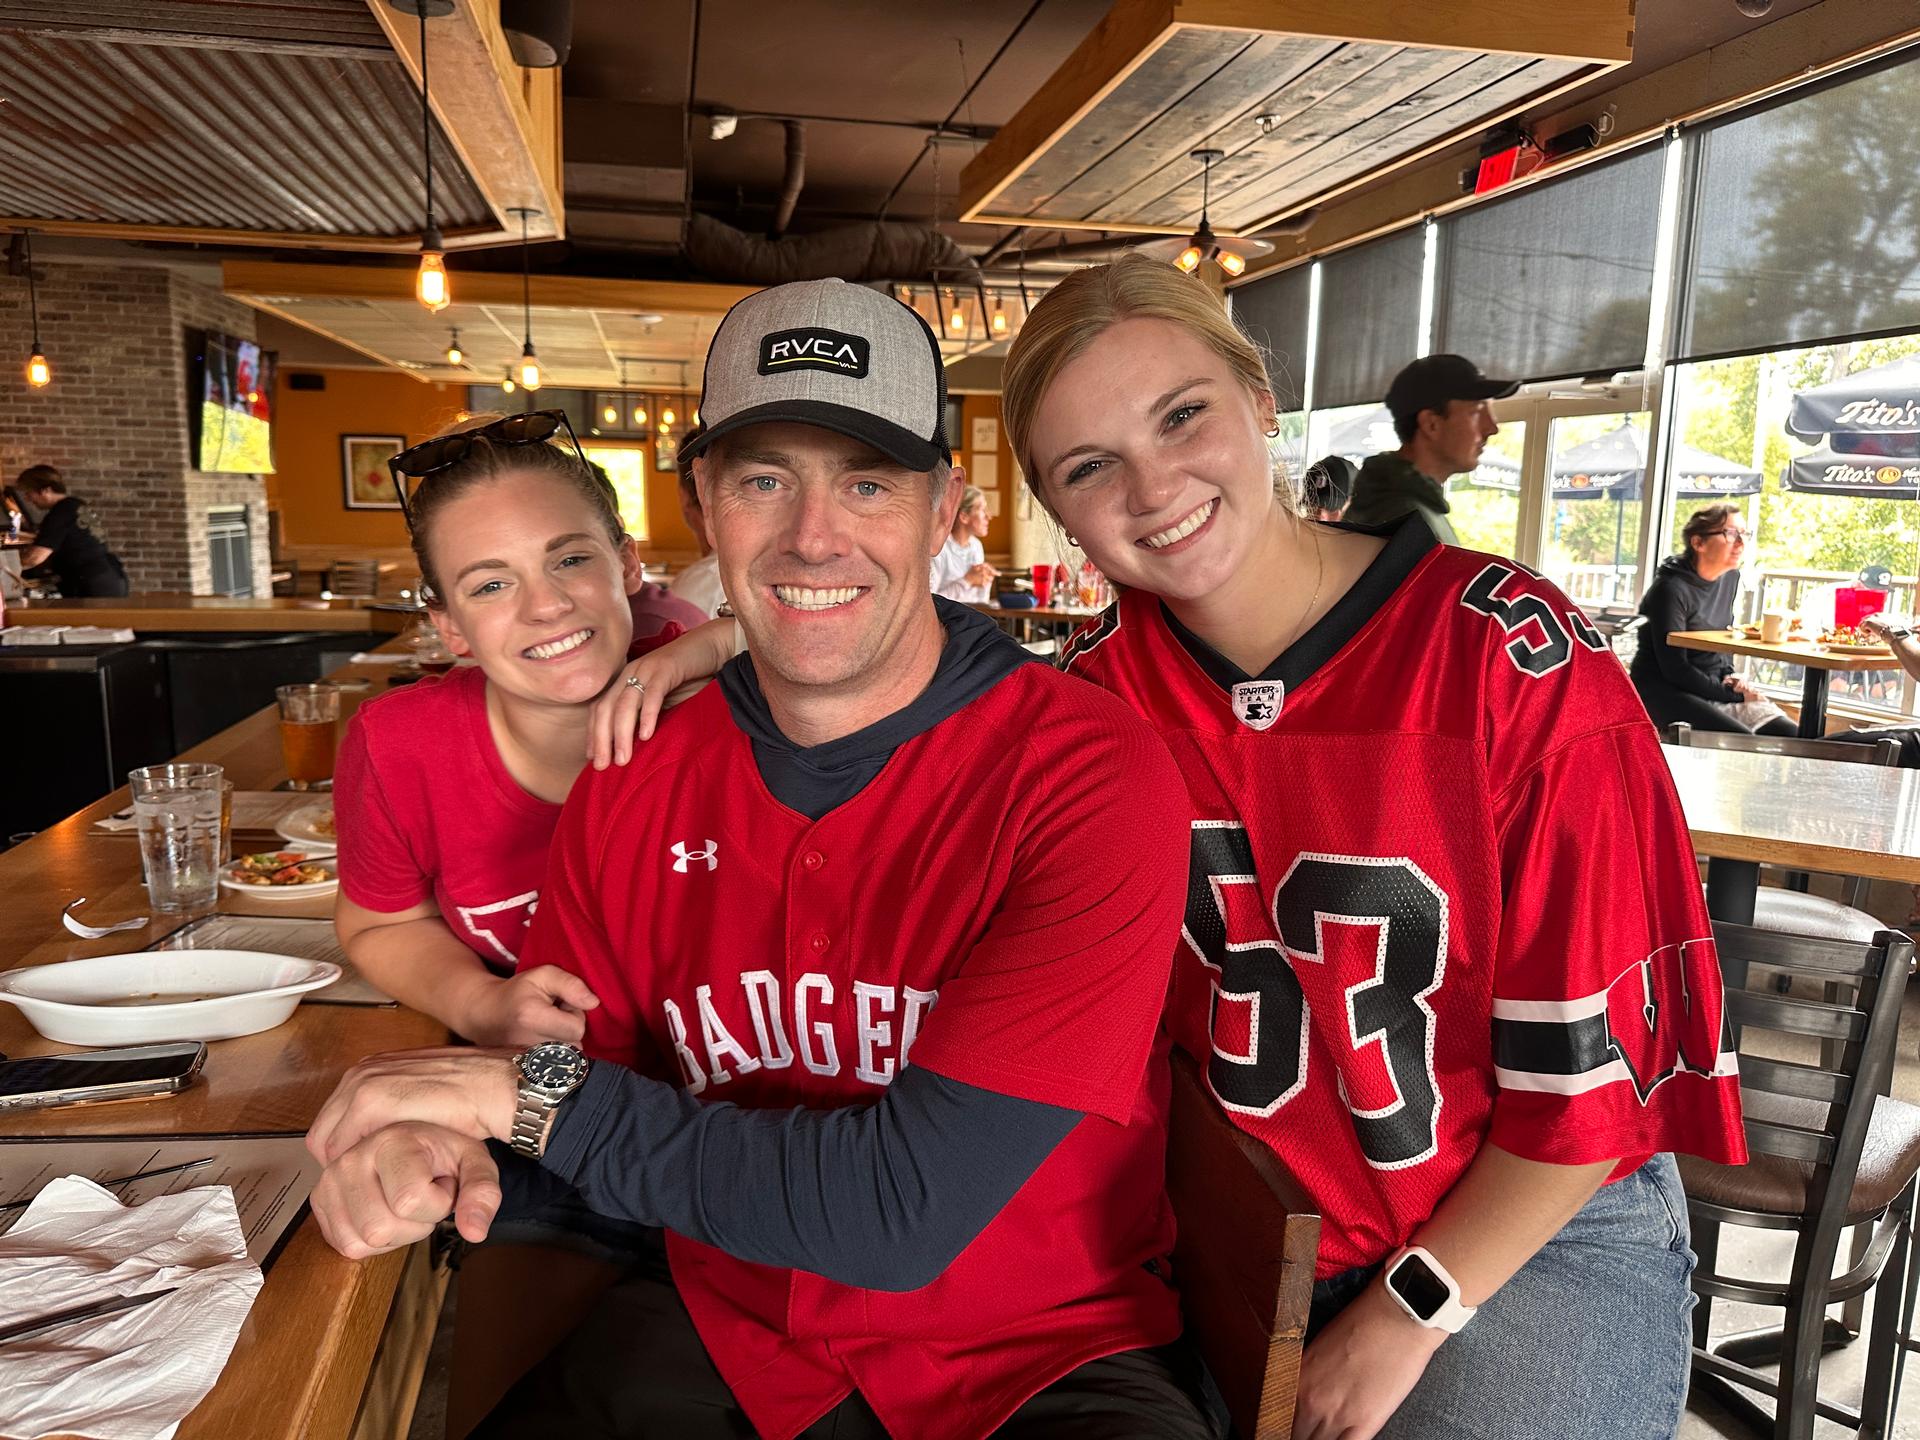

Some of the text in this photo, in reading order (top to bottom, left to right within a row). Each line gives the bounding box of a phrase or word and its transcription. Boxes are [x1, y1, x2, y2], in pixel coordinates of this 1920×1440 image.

[770, 337, 859, 363] RVCA
[1835, 398, 1920, 426] Tito's
[1238, 685, 1275, 696] STARTER
[1239, 693, 1275, 702] TEAM
[1180, 819, 1450, 1172] 53
